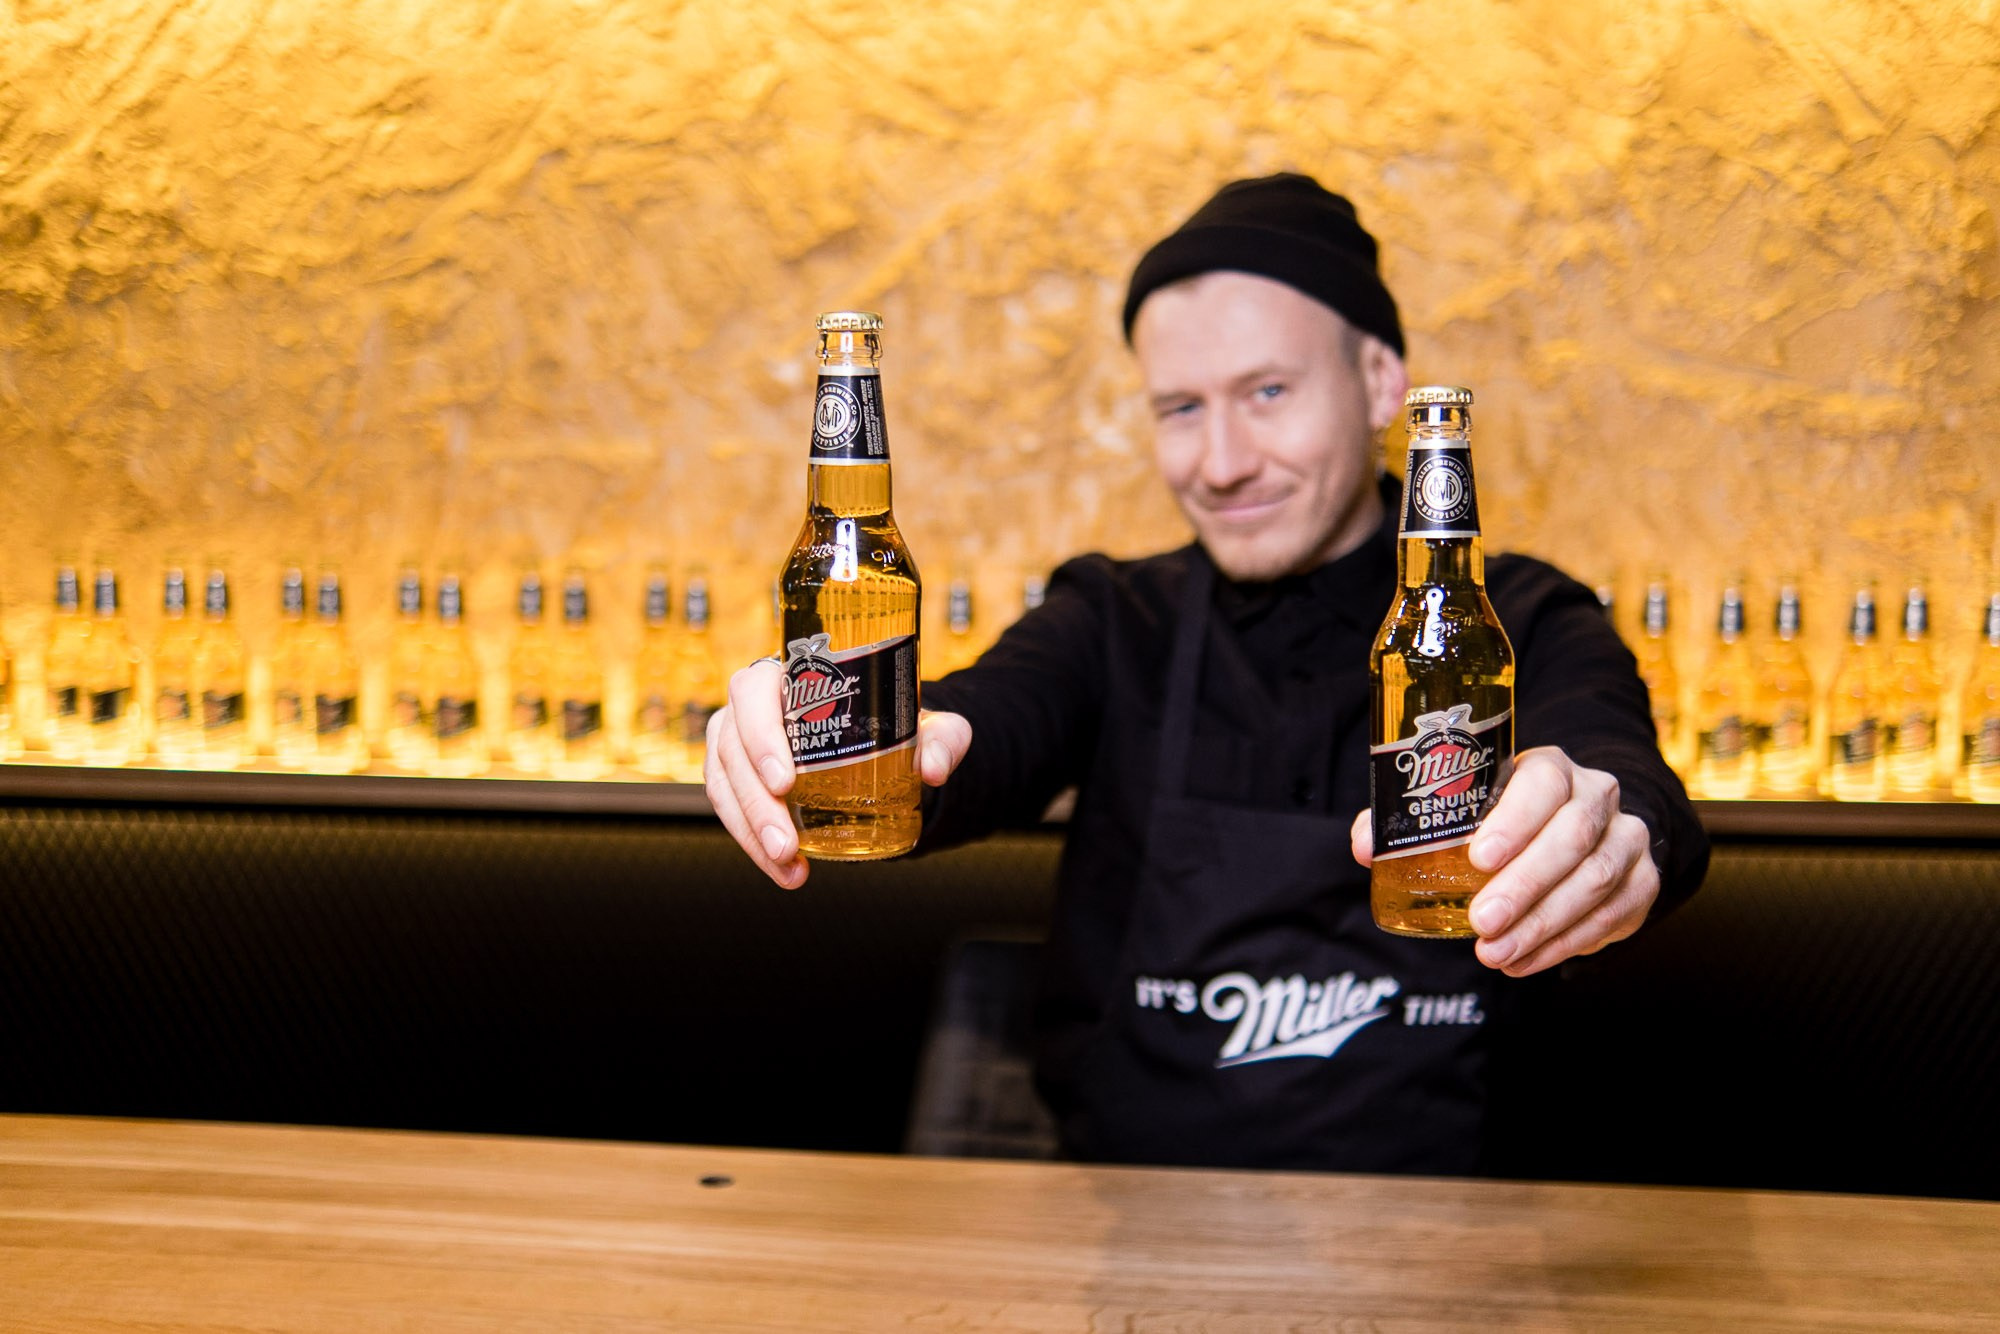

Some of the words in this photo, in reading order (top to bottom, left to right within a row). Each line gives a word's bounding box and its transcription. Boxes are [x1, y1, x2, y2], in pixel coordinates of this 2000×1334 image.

[1415, 463, 1433, 488] MILLER
[782, 674, 860, 714] Miller
[787, 714, 851, 738] GENUINE
[792, 731, 843, 751] DRAFT
[801, 750, 836, 761] EXCEPTIONAL
[837, 740, 877, 755] SMOOTHNESS
[1395, 747, 1495, 790] Miller
[1409, 786, 1488, 816] GENUINE
[1419, 803, 1480, 830] DRAFT
[1394, 836, 1419, 845] FILTERED
[1420, 833, 1432, 841] FOR
[1433, 825, 1474, 838] EXCEPTIONAL
[1201, 971, 1399, 1061] Miller
